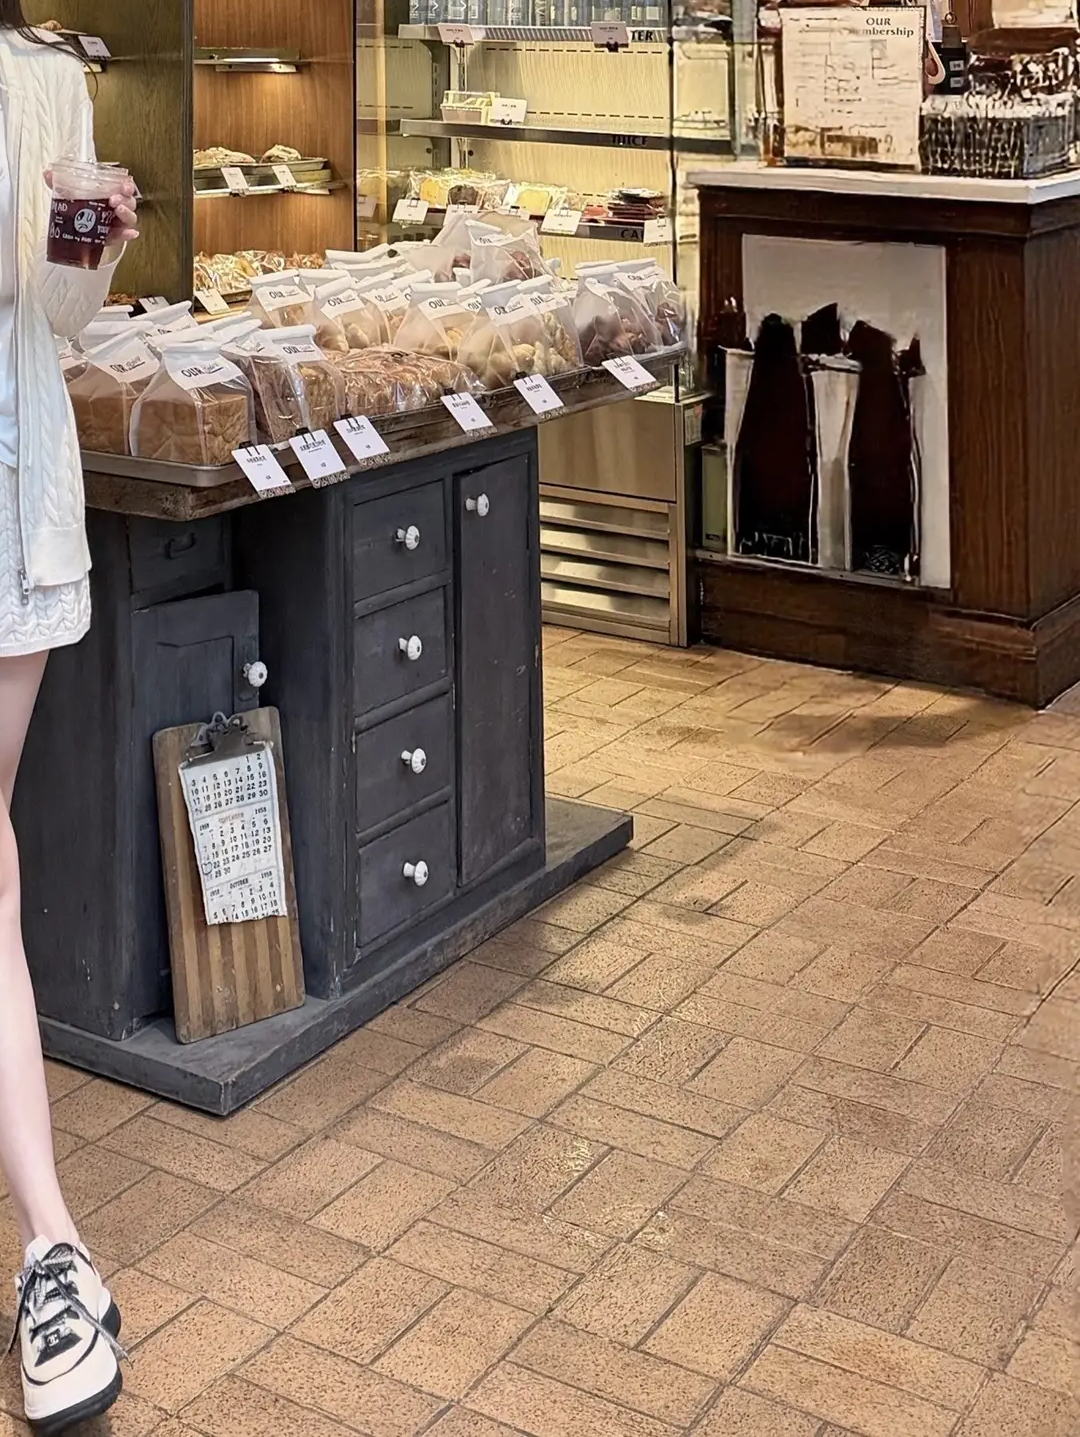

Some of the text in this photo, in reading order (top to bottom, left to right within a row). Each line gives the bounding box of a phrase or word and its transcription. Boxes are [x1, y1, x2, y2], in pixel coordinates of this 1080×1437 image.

[866, 17, 891, 26] OUR
[631, 30, 654, 41] TER
[849, 27, 914, 38] mbership
[621, 229, 644, 239] CA
[109, 363, 128, 373] OUR
[181, 367, 204, 378] OUR
